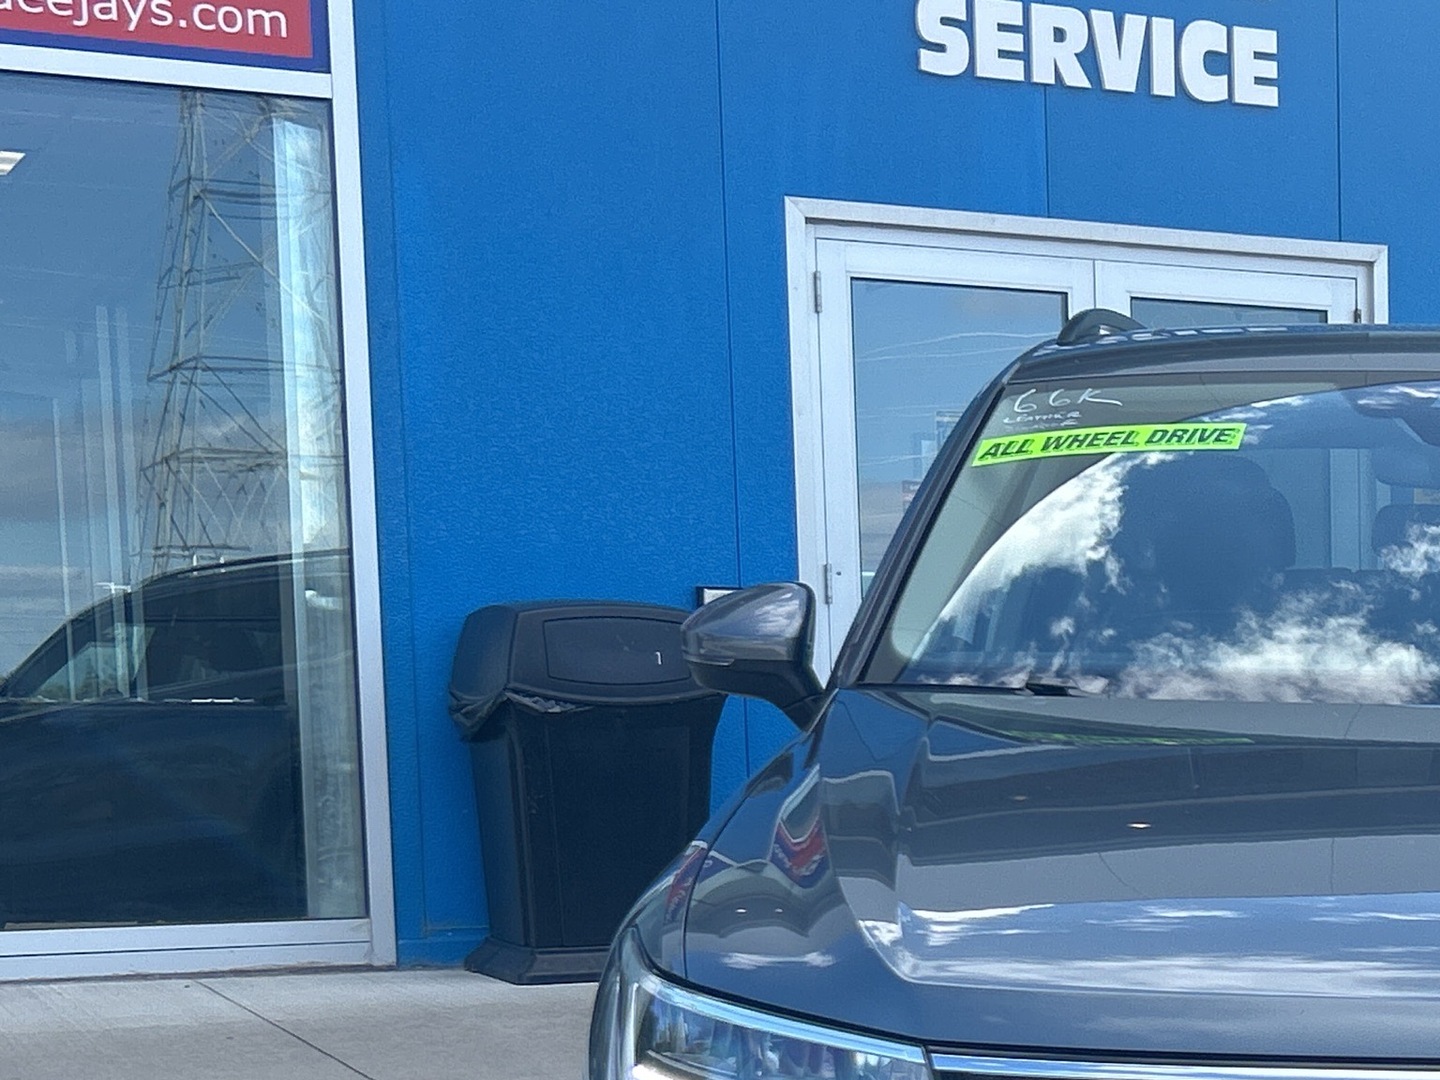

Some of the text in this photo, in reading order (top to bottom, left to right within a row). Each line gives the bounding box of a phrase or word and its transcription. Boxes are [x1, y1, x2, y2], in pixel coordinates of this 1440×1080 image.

[915, 0, 1280, 107] SERVICE
[978, 426, 1238, 462] ALL WHEEL DRIVE
